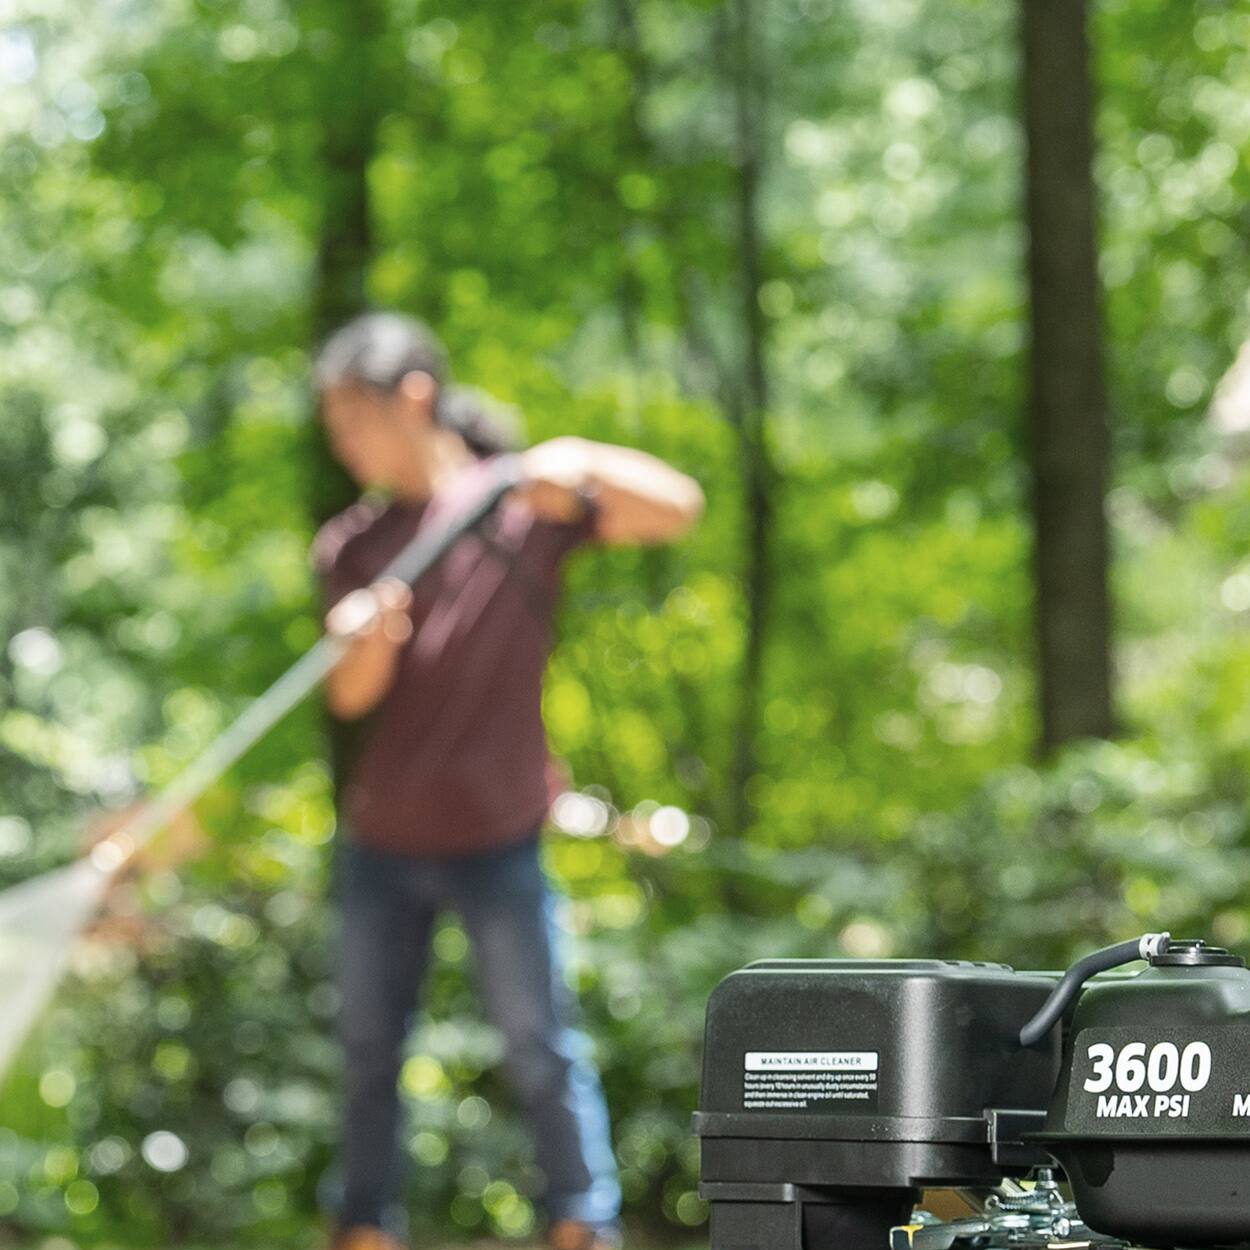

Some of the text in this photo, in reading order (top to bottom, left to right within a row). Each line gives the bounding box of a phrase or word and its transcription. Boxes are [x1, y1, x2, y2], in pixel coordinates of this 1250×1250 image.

[760, 1057, 862, 1066] MAINTAIN AIR CLEANER
[1083, 1041, 1212, 1093] 3600
[1096, 1094, 1190, 1117] MAX PSI
